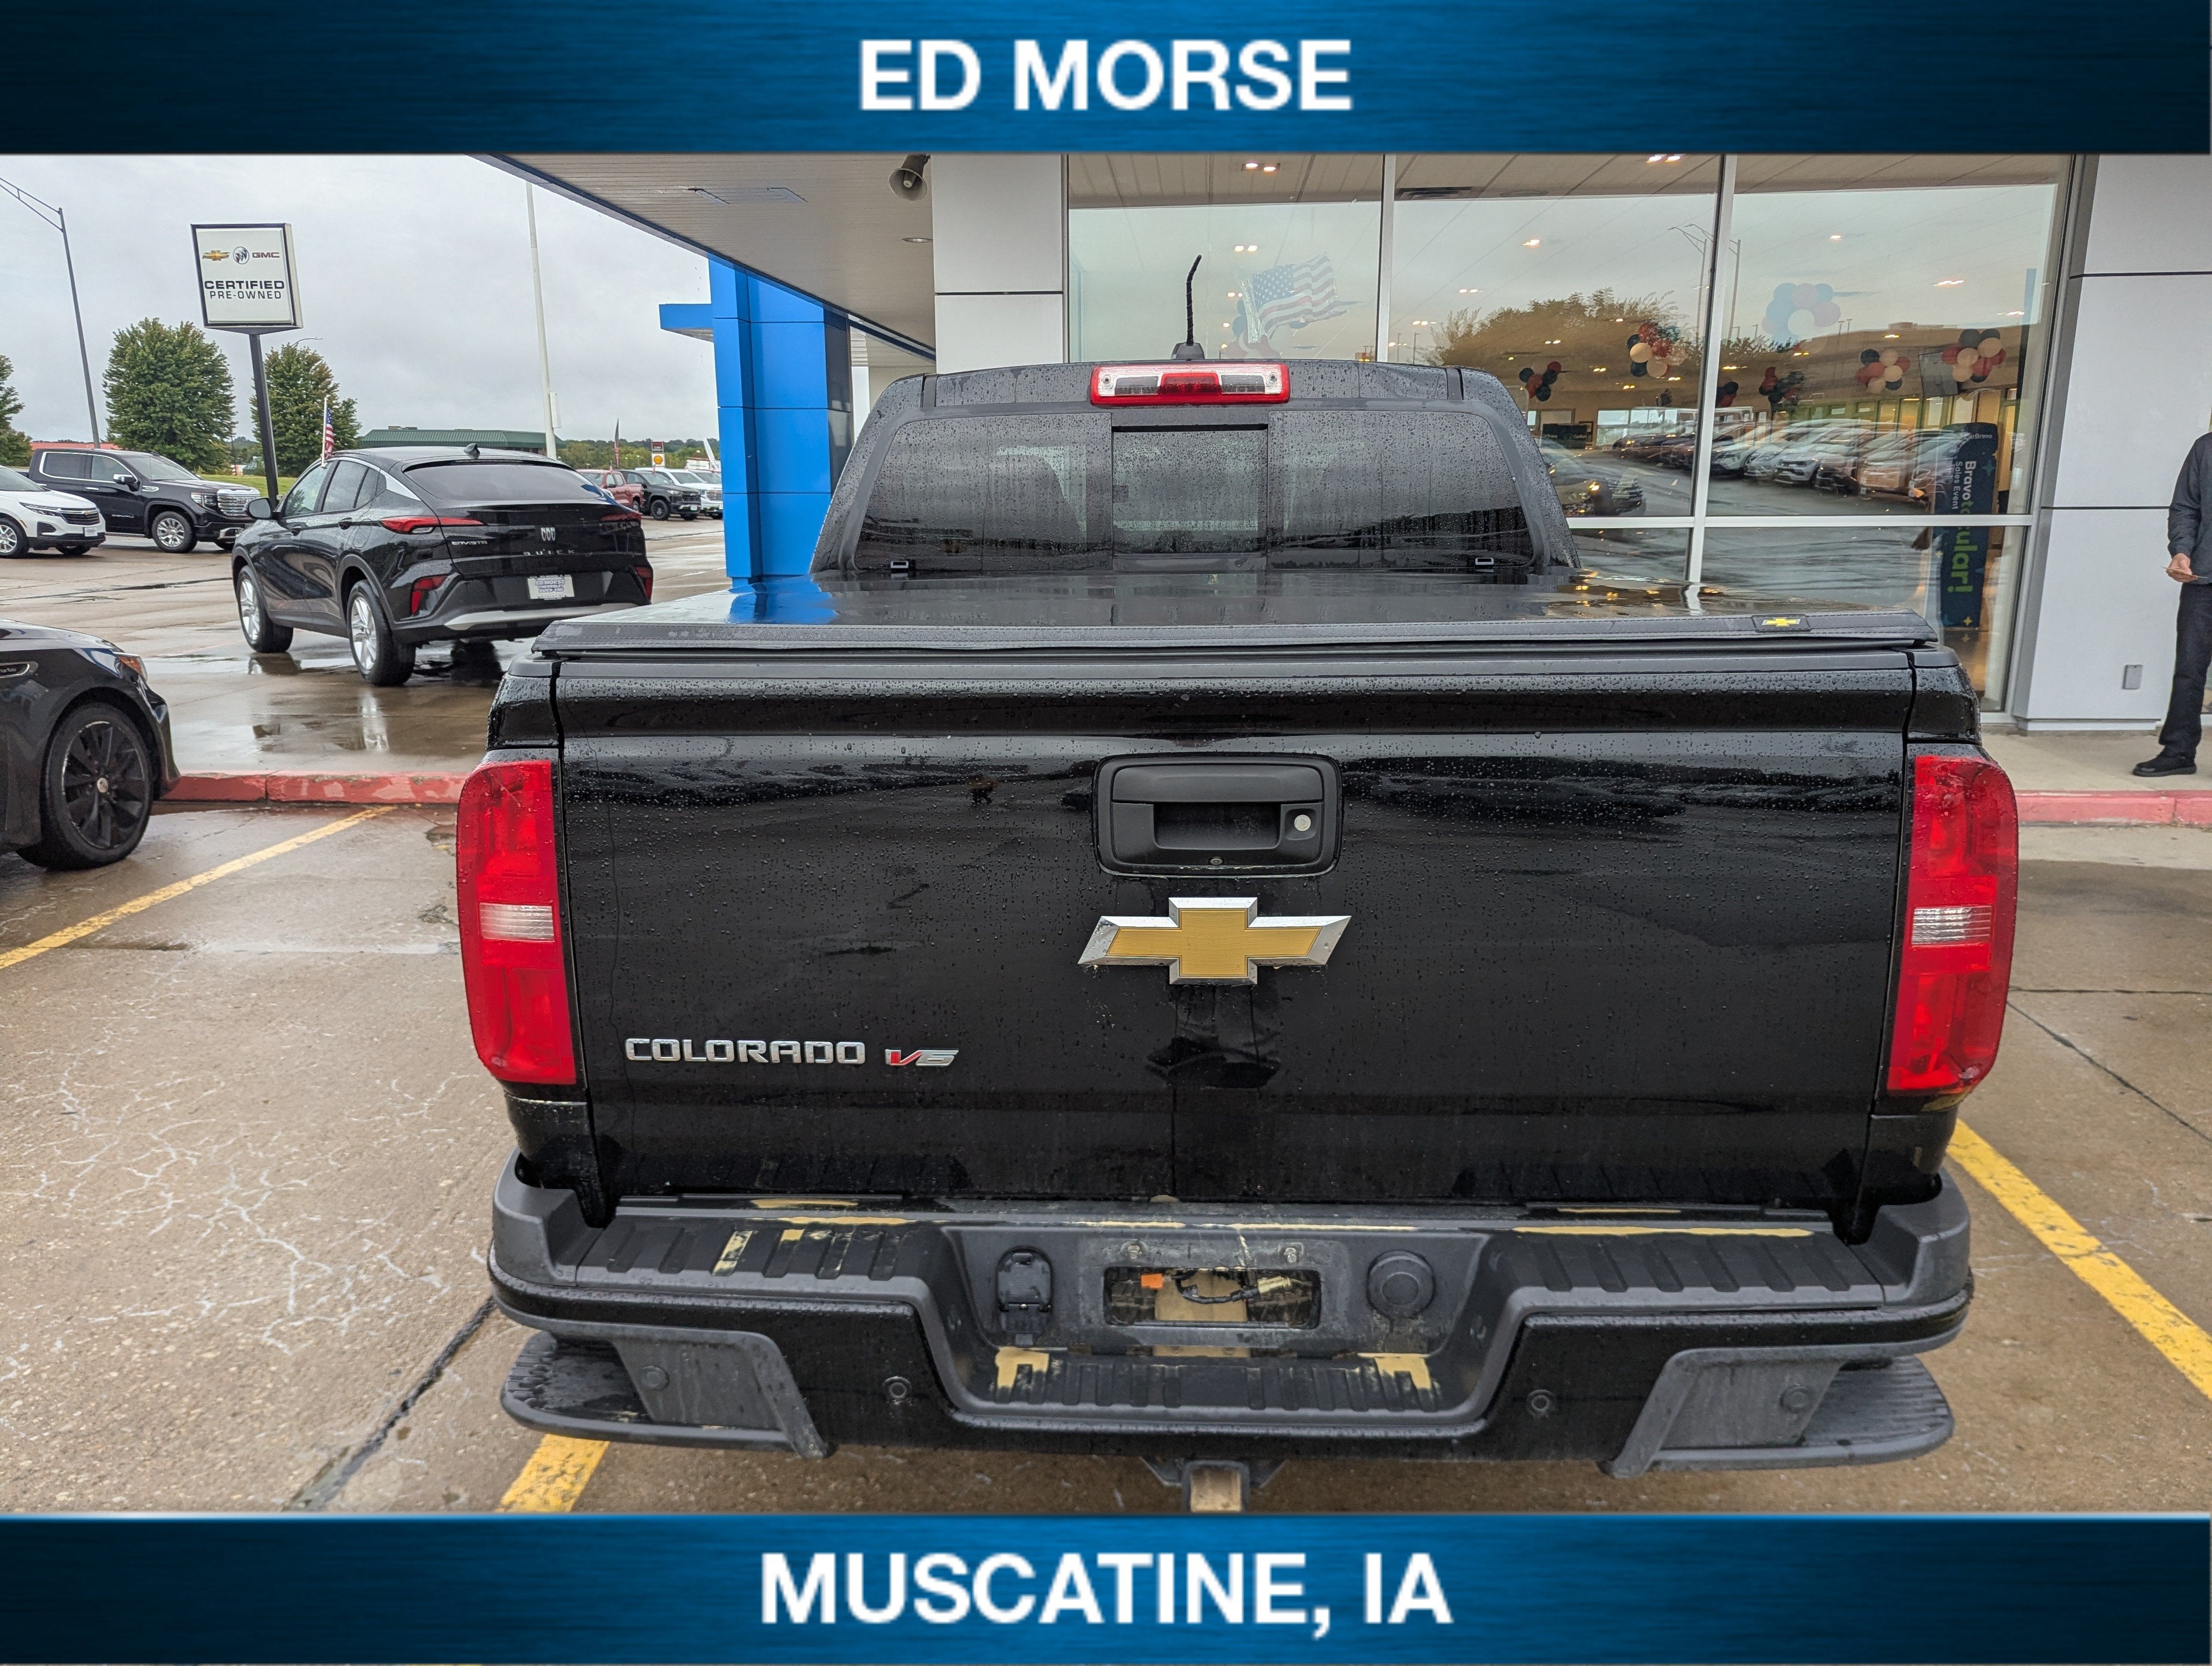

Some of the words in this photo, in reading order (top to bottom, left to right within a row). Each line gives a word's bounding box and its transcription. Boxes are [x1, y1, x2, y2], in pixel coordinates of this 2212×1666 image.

[204, 280, 285, 290] CERTIFIED
[209, 291, 281, 299] PRE-OWNED
[1954, 461, 1963, 484] Sales
[1952, 486, 1961, 510] Event
[624, 1038, 866, 1065] COLORADO
[884, 1047, 960, 1067] V6
